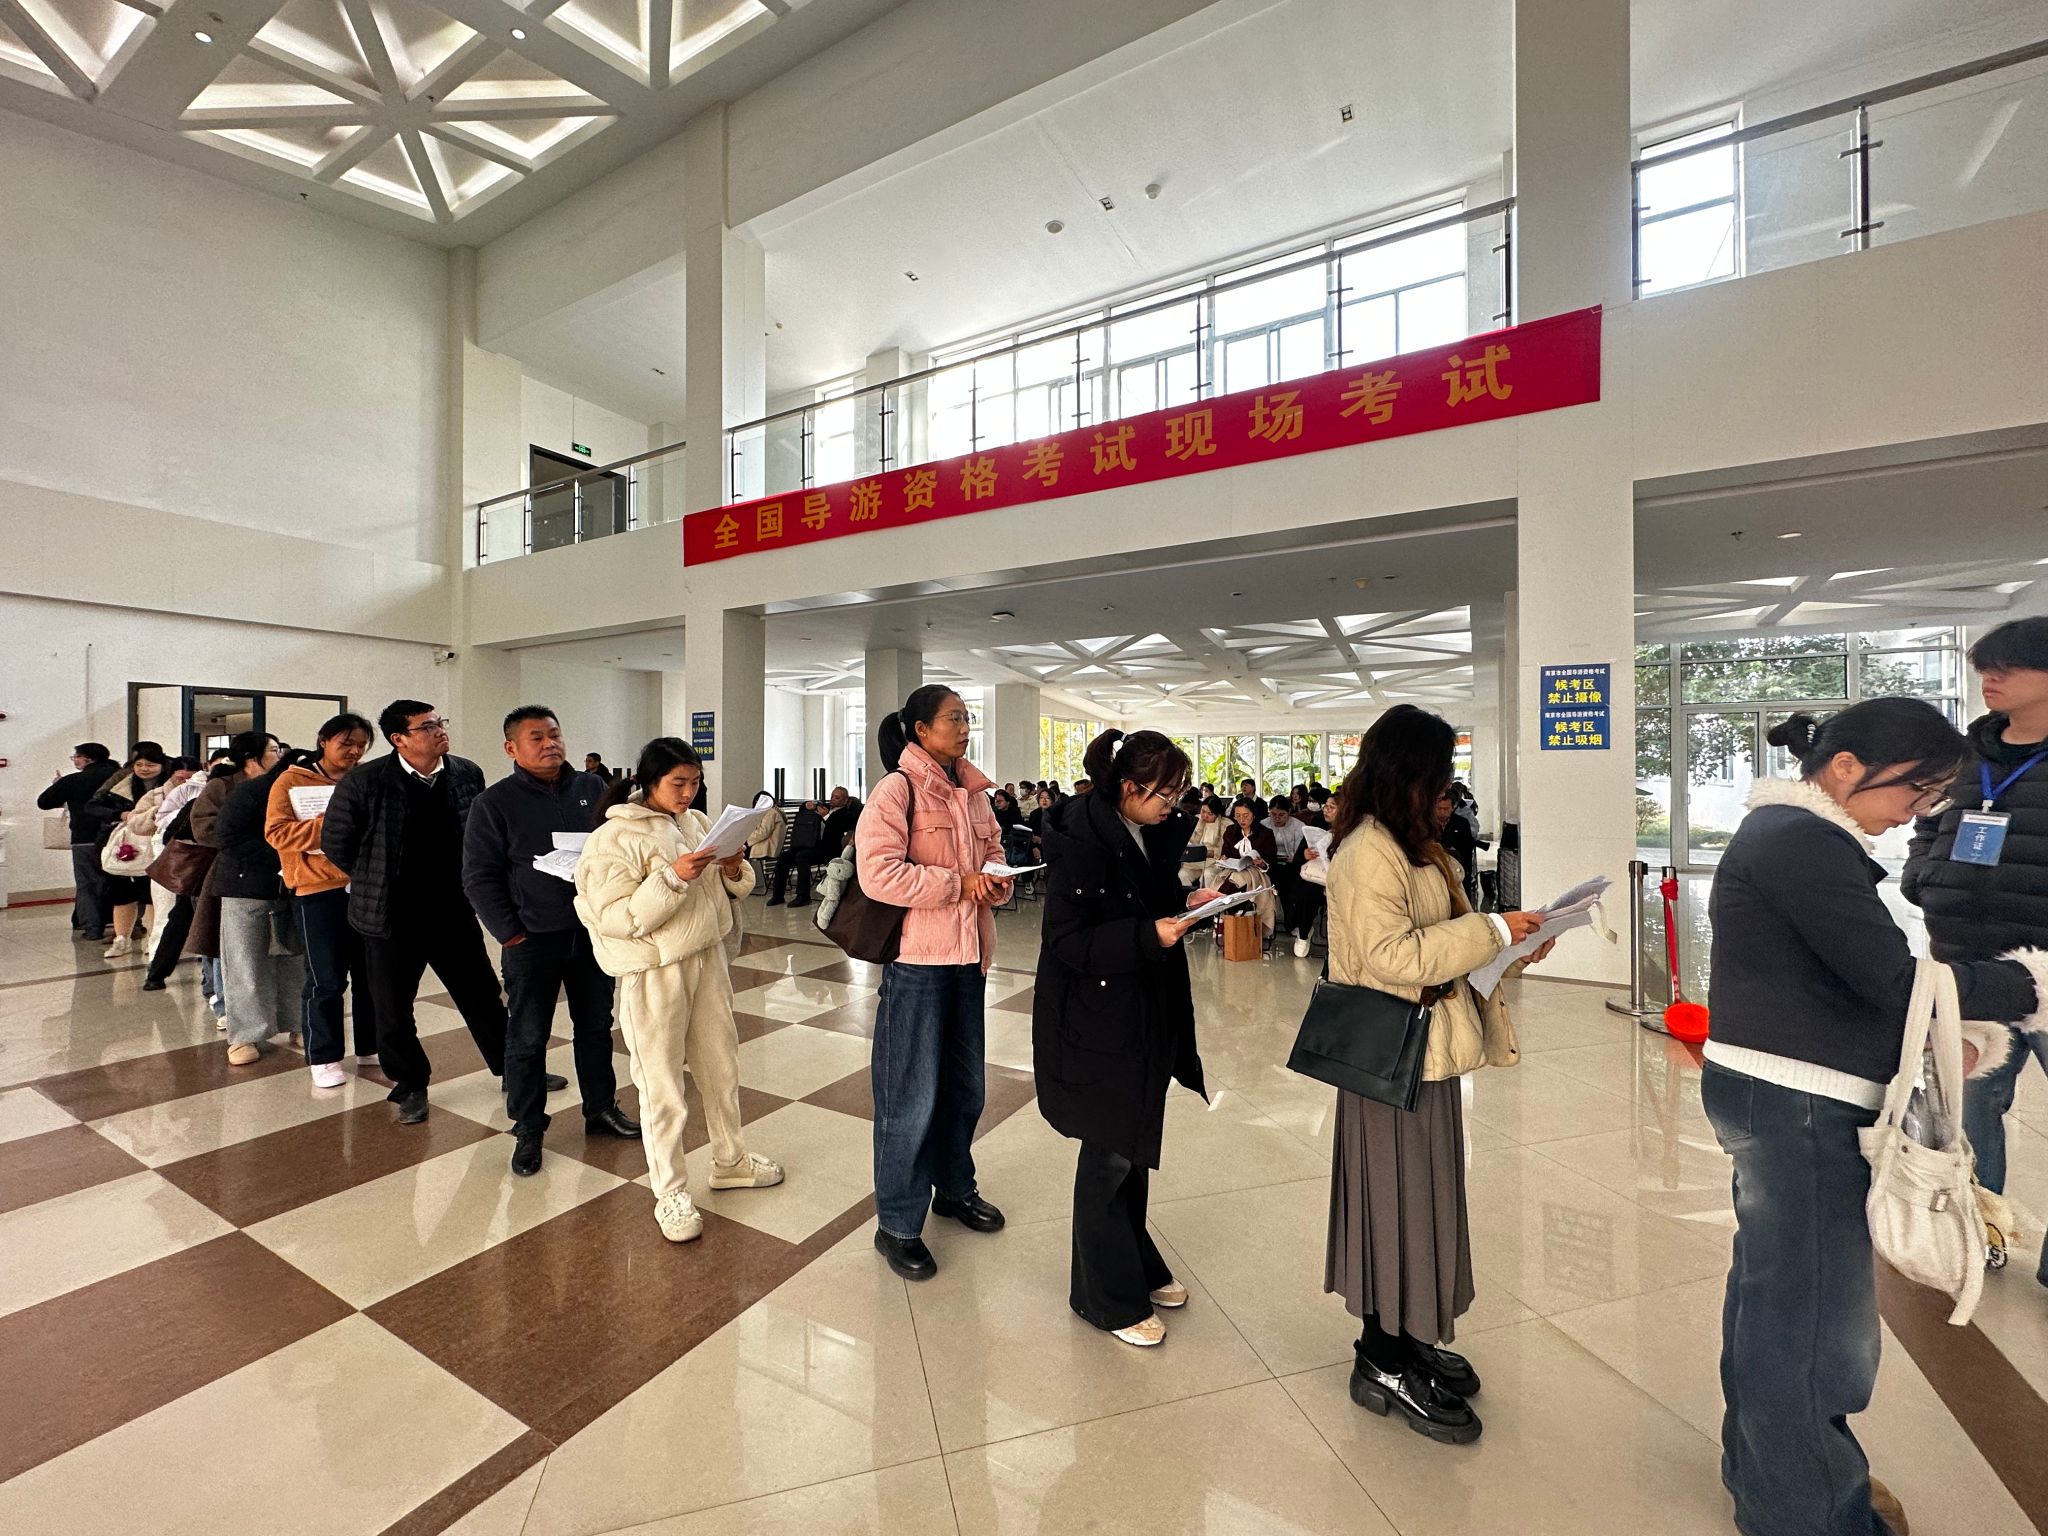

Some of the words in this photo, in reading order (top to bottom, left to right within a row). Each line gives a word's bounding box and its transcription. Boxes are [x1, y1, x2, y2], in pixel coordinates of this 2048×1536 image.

[713, 343, 1513, 549] 全国导游资格考试现场考试
[1554, 678, 1595, 691] 候考区
[1547, 691, 1602, 704] 禁止摄像
[1554, 721, 1595, 733] 候考区
[1548, 734, 1603, 746] 禁止吸烟
[1972, 826, 1989, 851] 工作证
